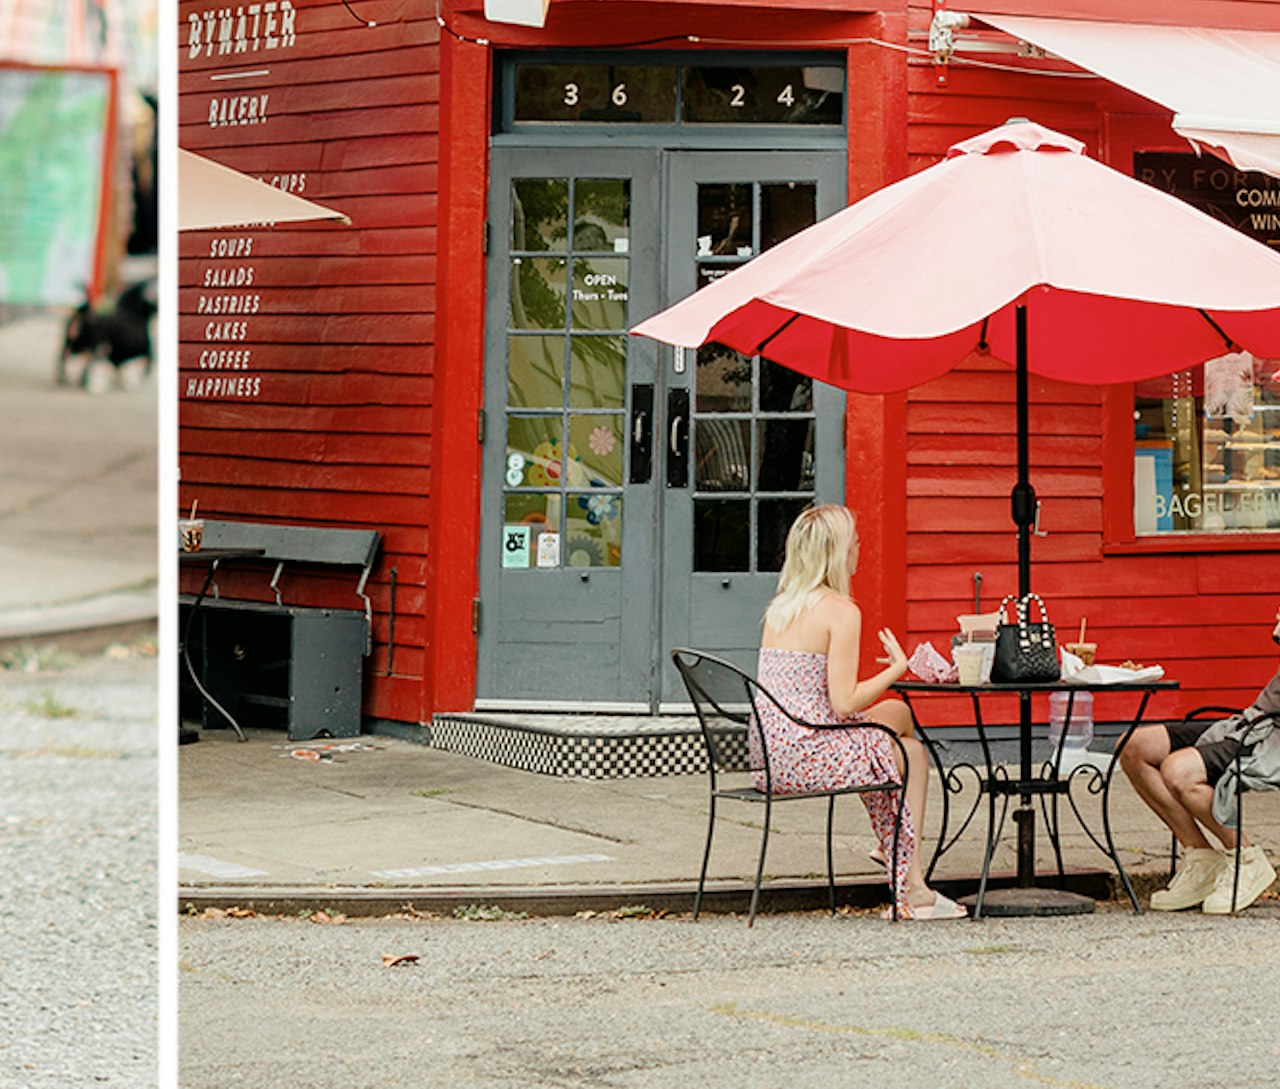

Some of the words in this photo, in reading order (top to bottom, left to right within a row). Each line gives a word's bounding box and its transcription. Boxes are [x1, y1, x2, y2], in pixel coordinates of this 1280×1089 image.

[187, 0, 297, 59] BYWATER
[208, 94, 269, 128] BAKERY
[209, 237, 254, 258] SOUPS
[204, 267, 255, 287] SALADS
[583, 274, 617, 287] OPEN
[197, 295, 261, 314] PASTRIES
[205, 321, 248, 341] CAKES
[199, 350, 251, 370] COFFEE
[186, 377, 262, 398] HAPPINESS
[1153, 492, 1232, 518] BAGEL
